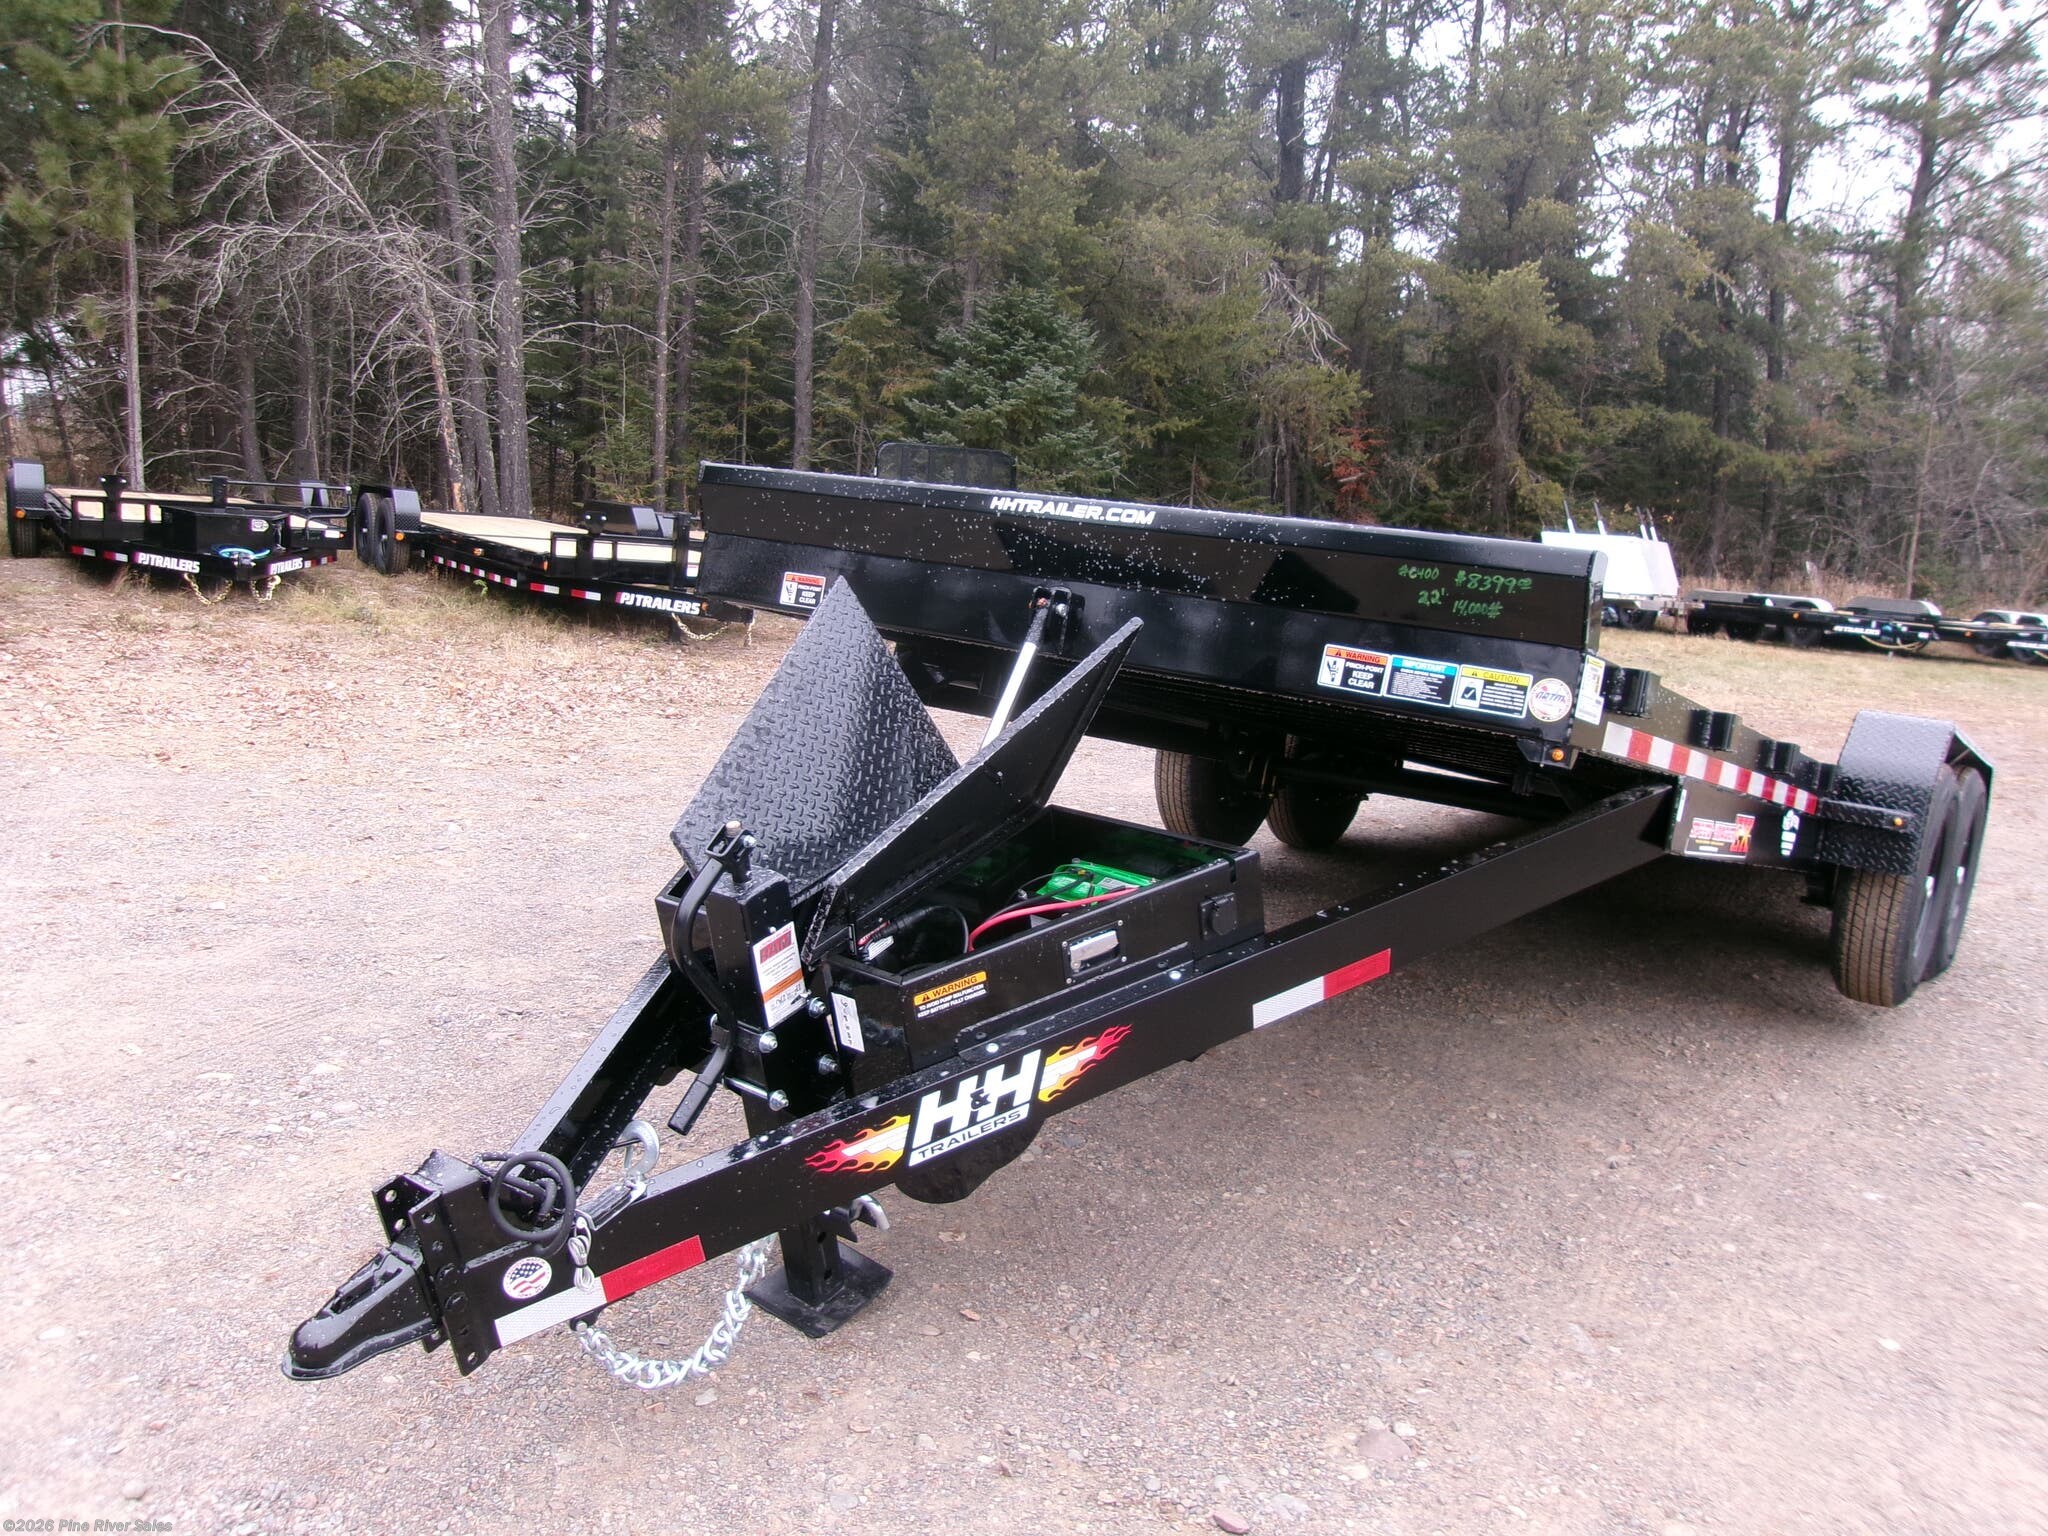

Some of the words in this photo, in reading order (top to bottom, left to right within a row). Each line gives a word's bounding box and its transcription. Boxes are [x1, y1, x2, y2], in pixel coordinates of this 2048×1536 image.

[989, 496, 1156, 525] HHTRAILER.COM
[1345, 651, 1381, 664] WARNING
[1347, 677, 1375, 690] CLEAR
[1352, 670, 1374, 681] KEEP
[1483, 671, 1521, 683] CAUTION
[933, 976, 978, 998] WARNING
[912, 1049, 1041, 1150] H&H
[918, 1109, 1021, 1159] TRAILERS
